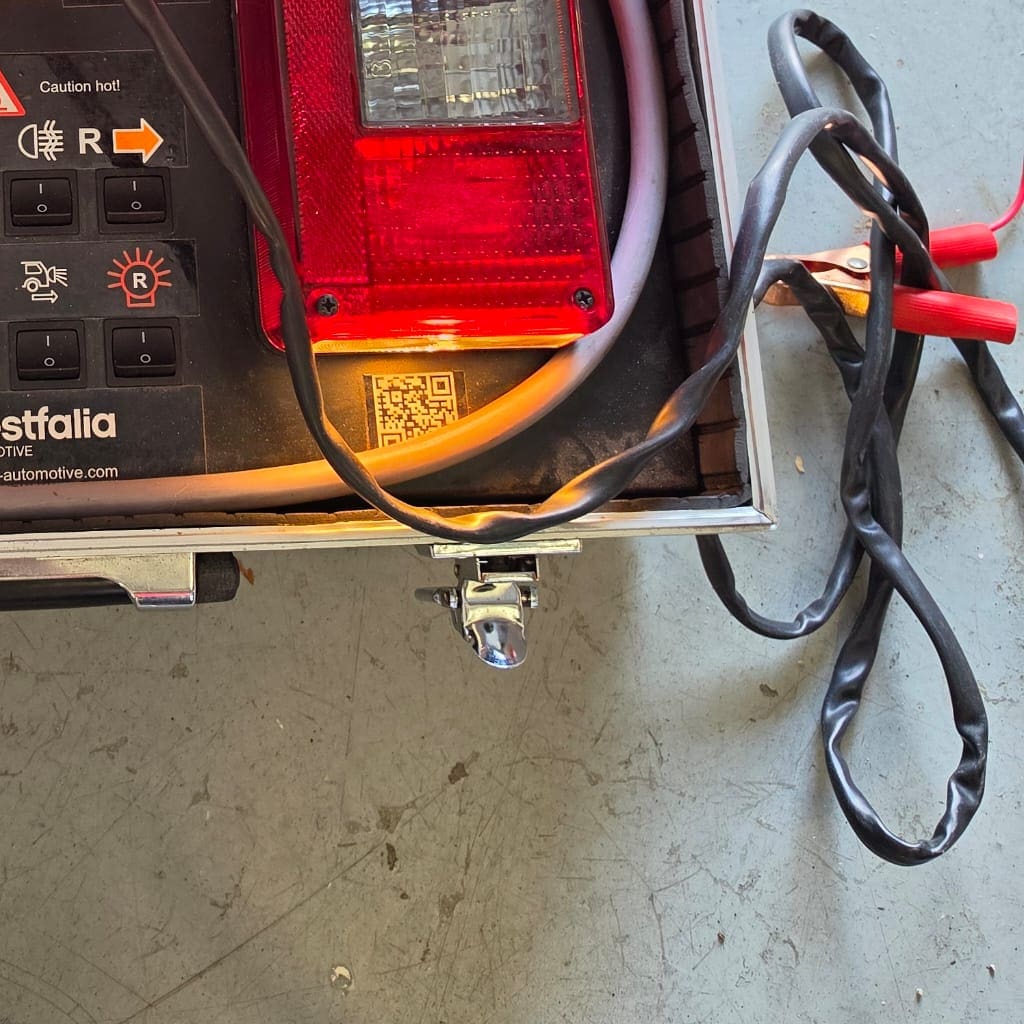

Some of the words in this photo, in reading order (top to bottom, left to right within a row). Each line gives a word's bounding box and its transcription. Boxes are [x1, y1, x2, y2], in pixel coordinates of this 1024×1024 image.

[39, 81, 91, 93] Caution
[95, 80, 121, 92] hot!
[78, 127, 103, 154] R
[132, 272, 148, 289] R
